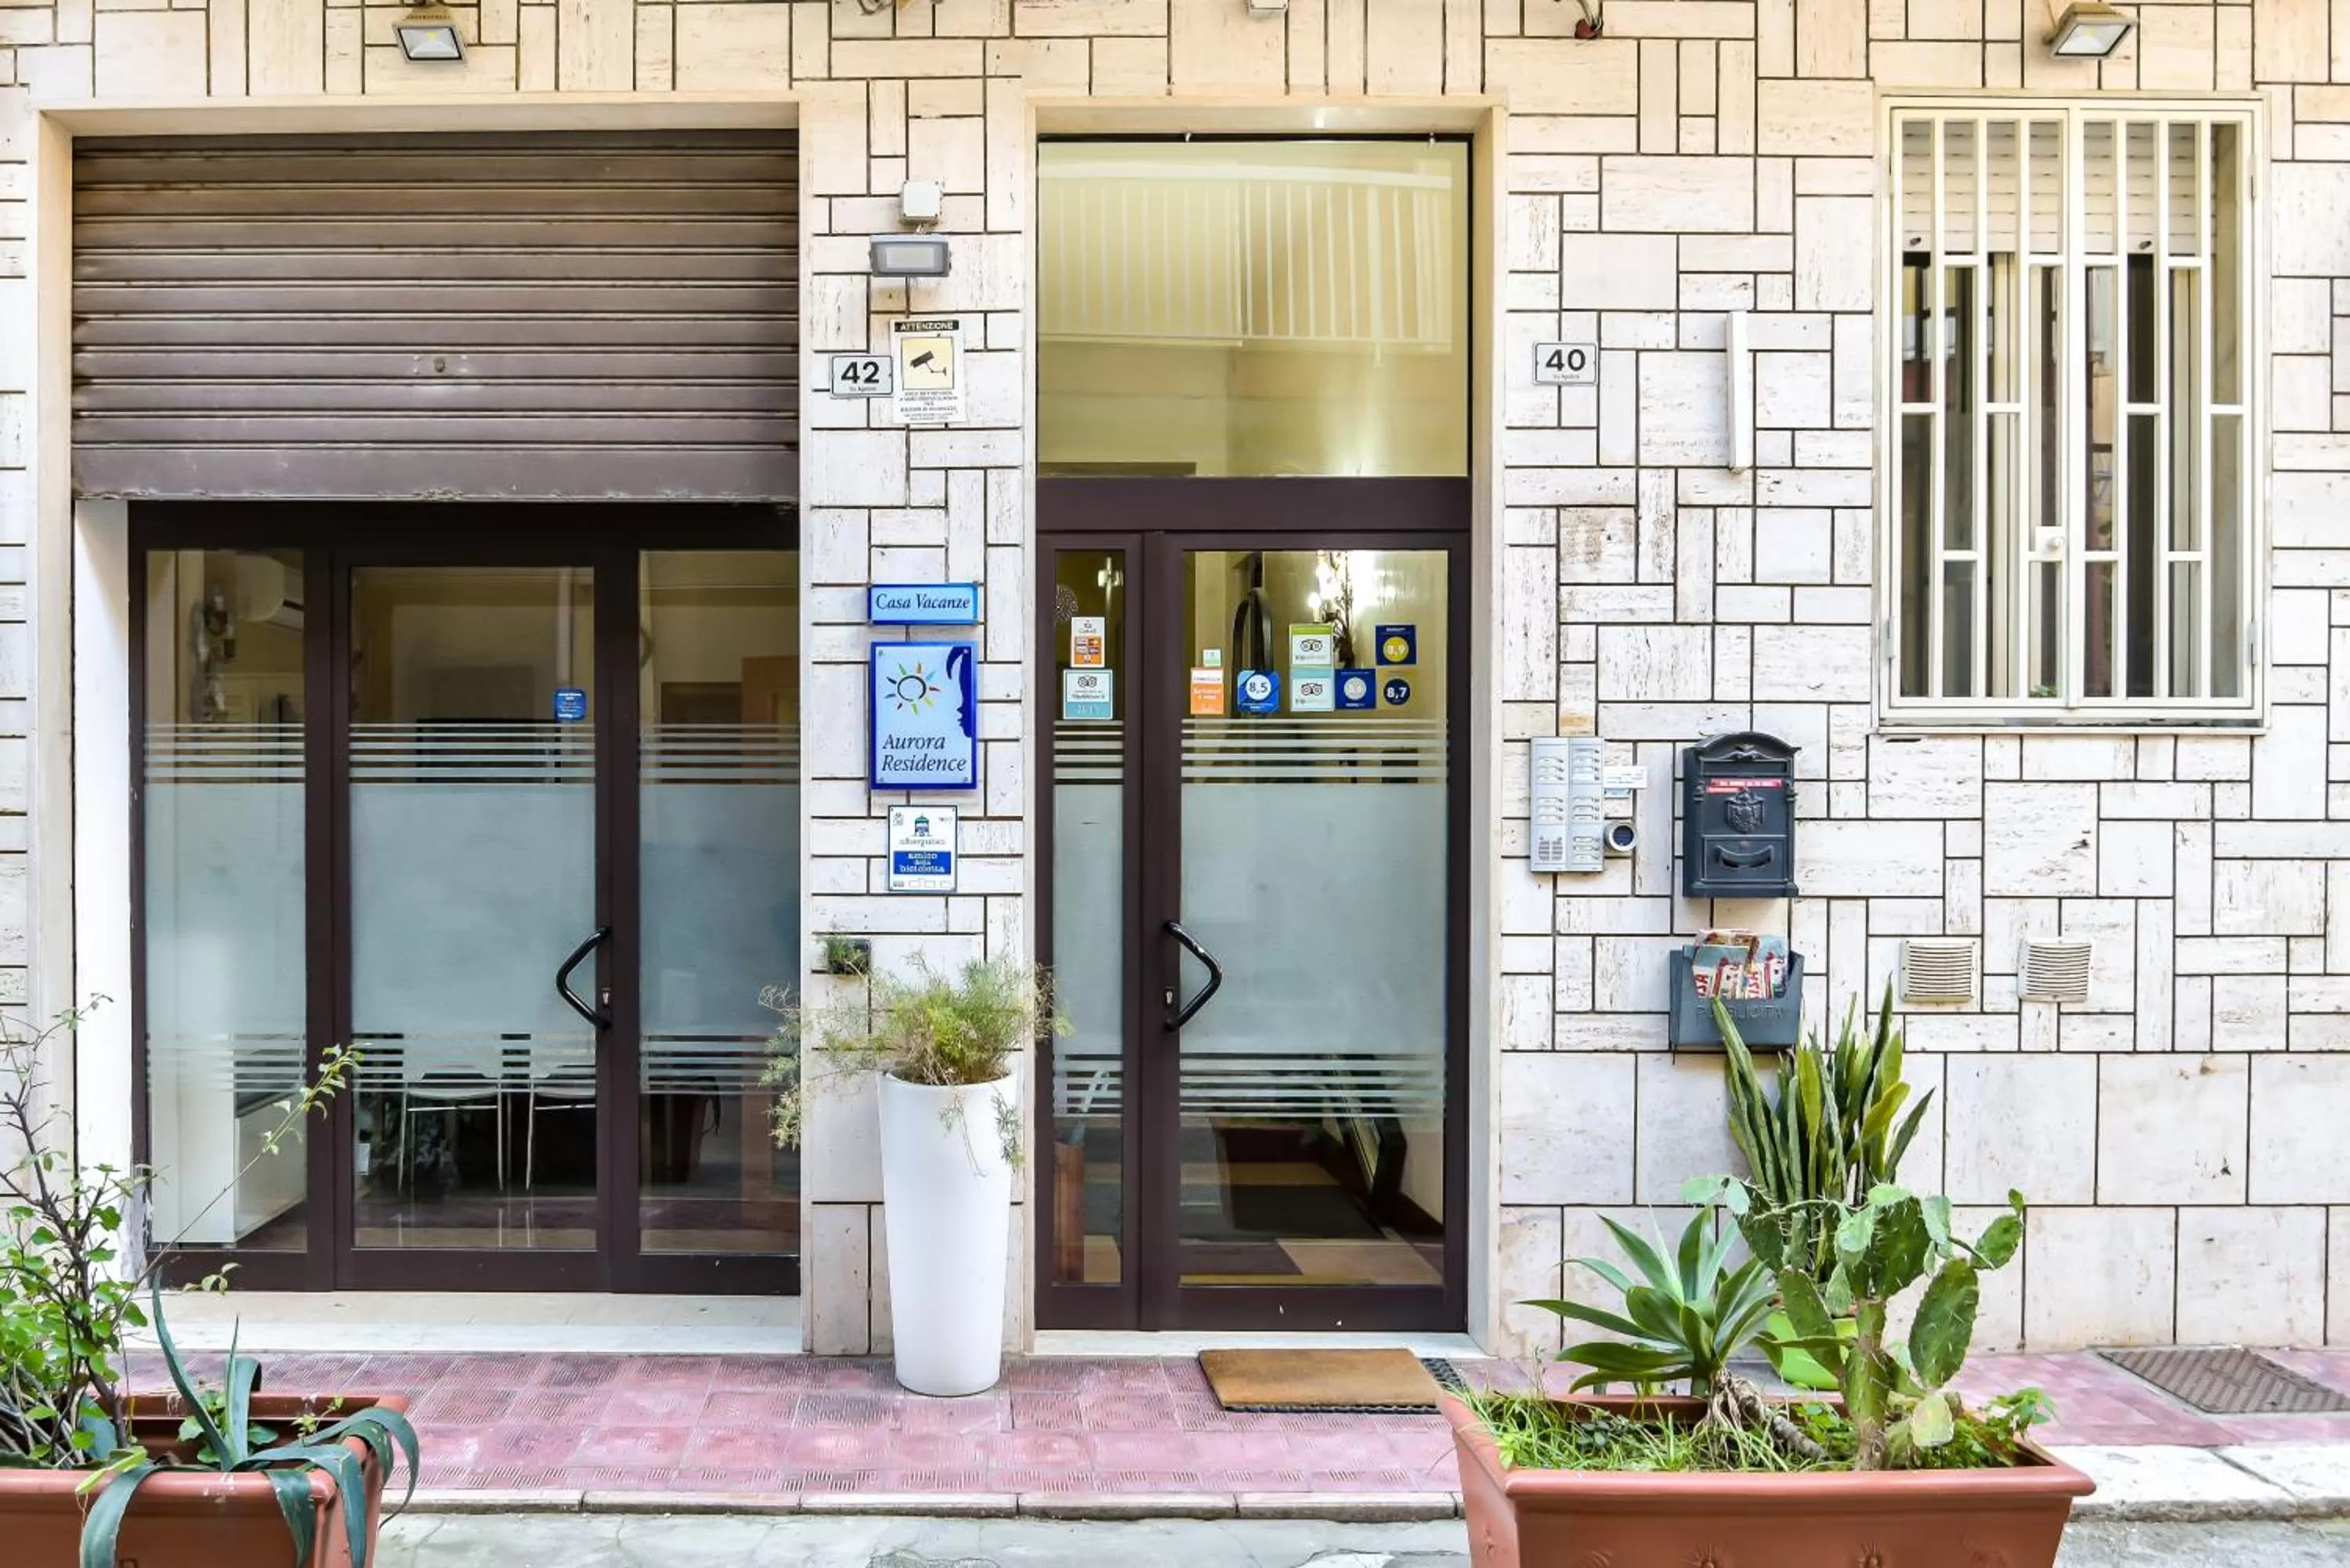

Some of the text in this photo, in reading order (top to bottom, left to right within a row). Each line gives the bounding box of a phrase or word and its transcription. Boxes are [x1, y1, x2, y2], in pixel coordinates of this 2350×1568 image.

[900, 321, 953, 331] ATTENZIONE
[1546, 349, 1586, 372] 40
[841, 361, 880, 384] 42
[876, 593, 971, 610] Casa Vacanze
[1249, 681, 1268, 695] 8,5
[1386, 686, 1408, 699] 8,7
[881, 734, 946, 750] Aurora
[881, 753, 967, 771] Residence
